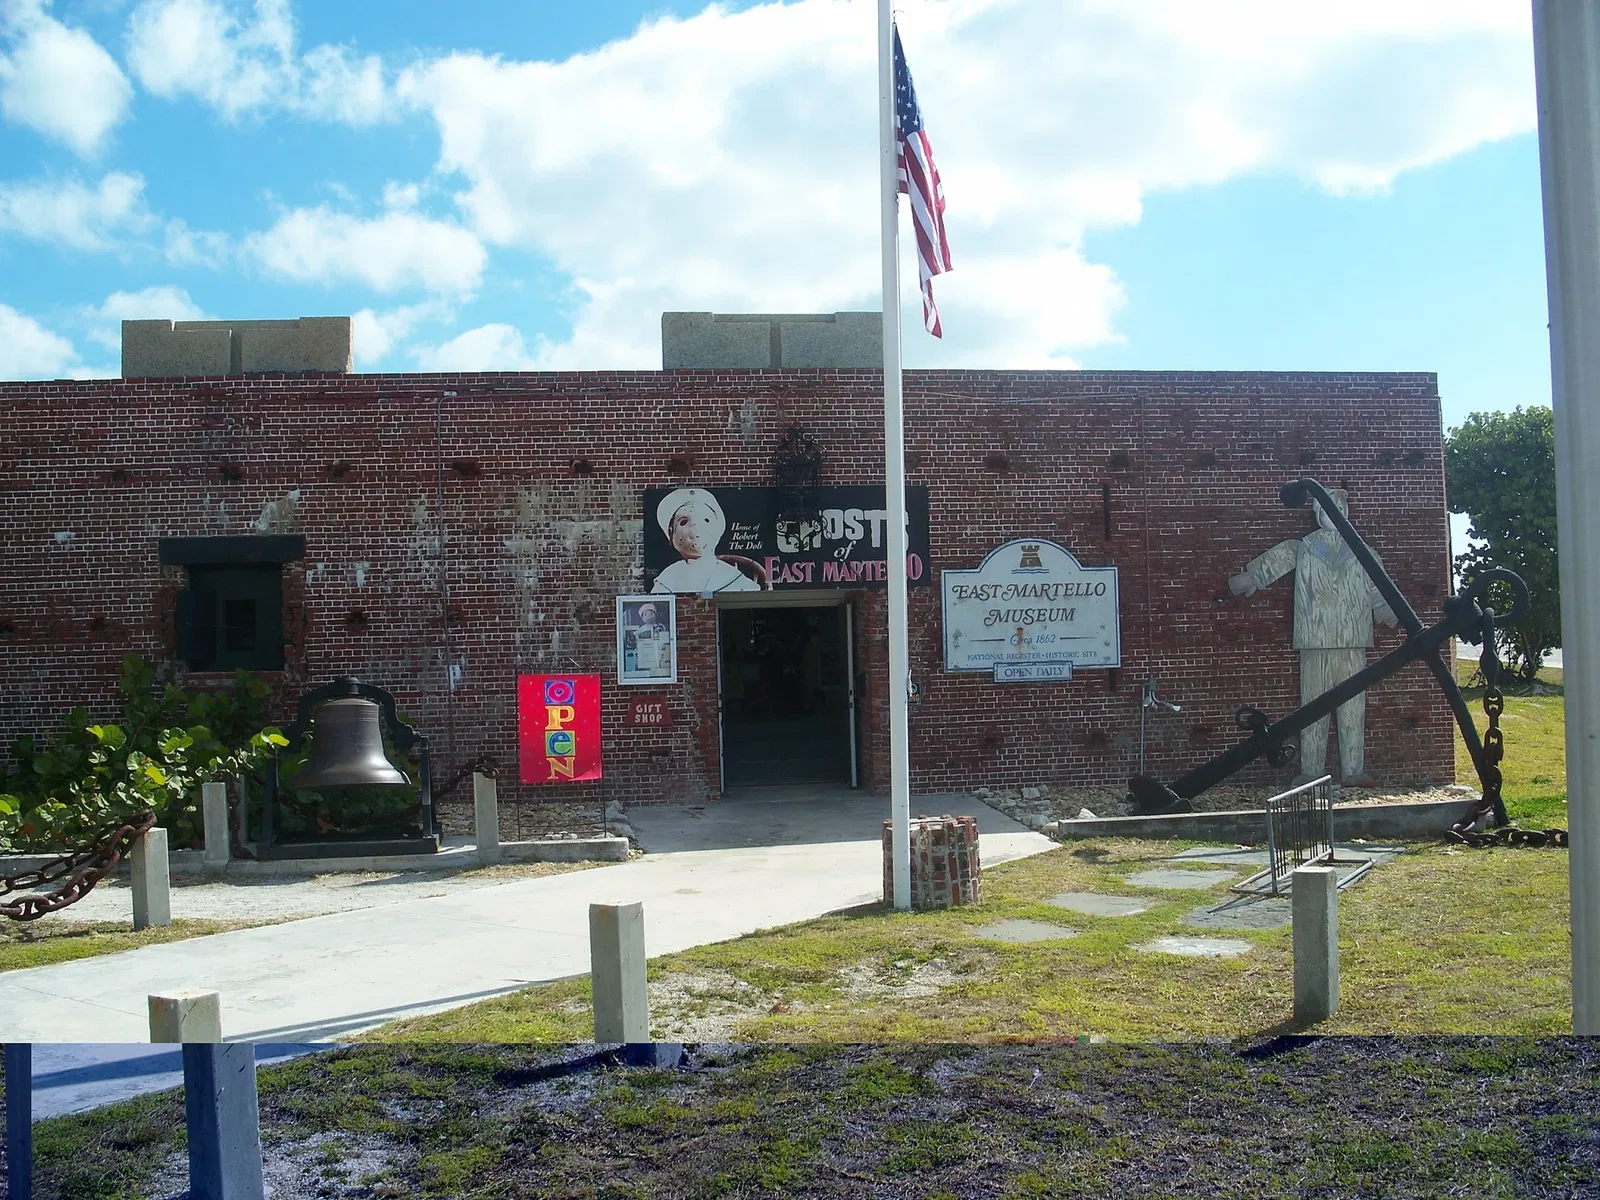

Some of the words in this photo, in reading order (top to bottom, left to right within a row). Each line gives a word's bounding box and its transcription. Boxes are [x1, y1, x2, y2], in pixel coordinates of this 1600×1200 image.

[731, 522, 751, 531] Home
[753, 523, 761, 532] of
[732, 532, 758, 540] Robert
[729, 541, 744, 550] The
[746, 541, 763, 550] Doll
[833, 540, 857, 562] of
[764, 555, 815, 584] EAST
[823, 553, 923, 583] MARTEO
[952, 583, 1002, 601] EAST
[1001, 582, 1107, 601] MARTELLO
[983, 608, 1076, 626] MUSEUM
[1036, 634, 1056, 644] 1862
[967, 653, 1004, 661] NATIONAL
[1004, 668, 1032, 678] OPEN
[1036, 667, 1065, 677] DAILY
[635, 704, 662, 713] GIFT
[634, 713, 663, 723] SHOP
